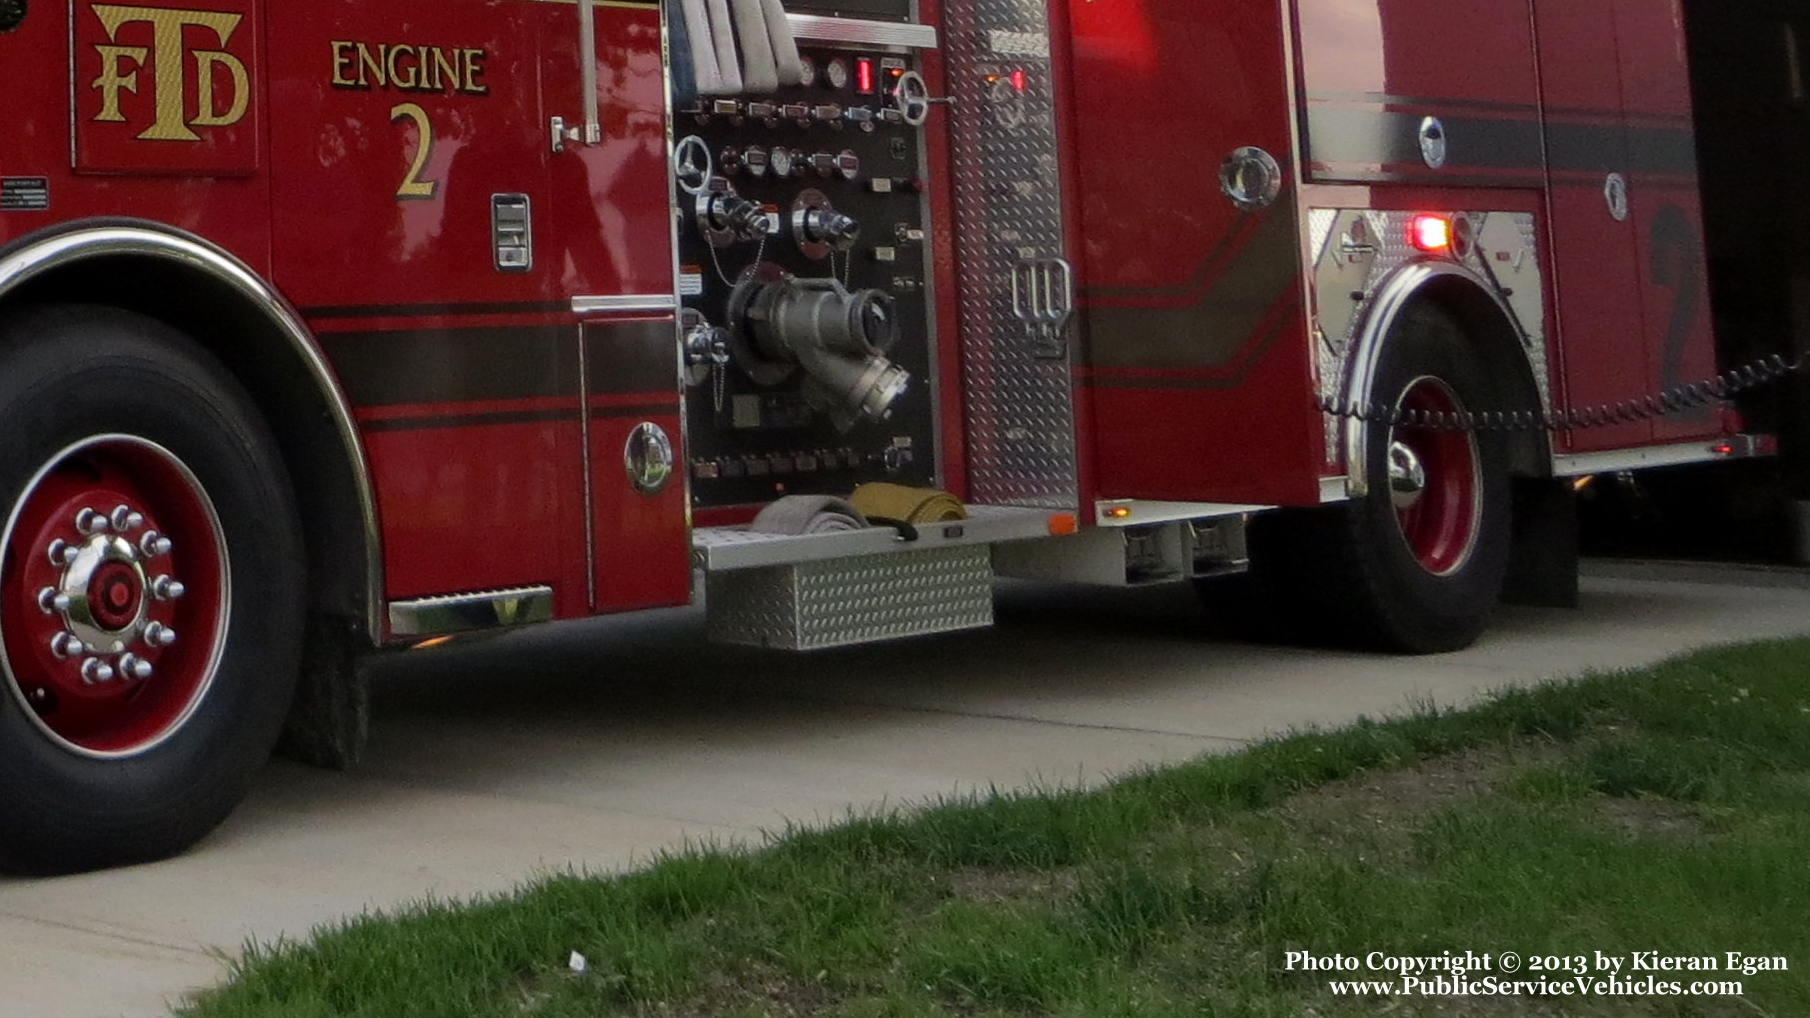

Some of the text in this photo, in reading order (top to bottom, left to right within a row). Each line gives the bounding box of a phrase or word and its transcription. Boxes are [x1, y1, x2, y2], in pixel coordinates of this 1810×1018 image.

[329, 39, 488, 94] ENGINE
[390, 101, 438, 201] 2
[1651, 203, 1712, 423] 2
